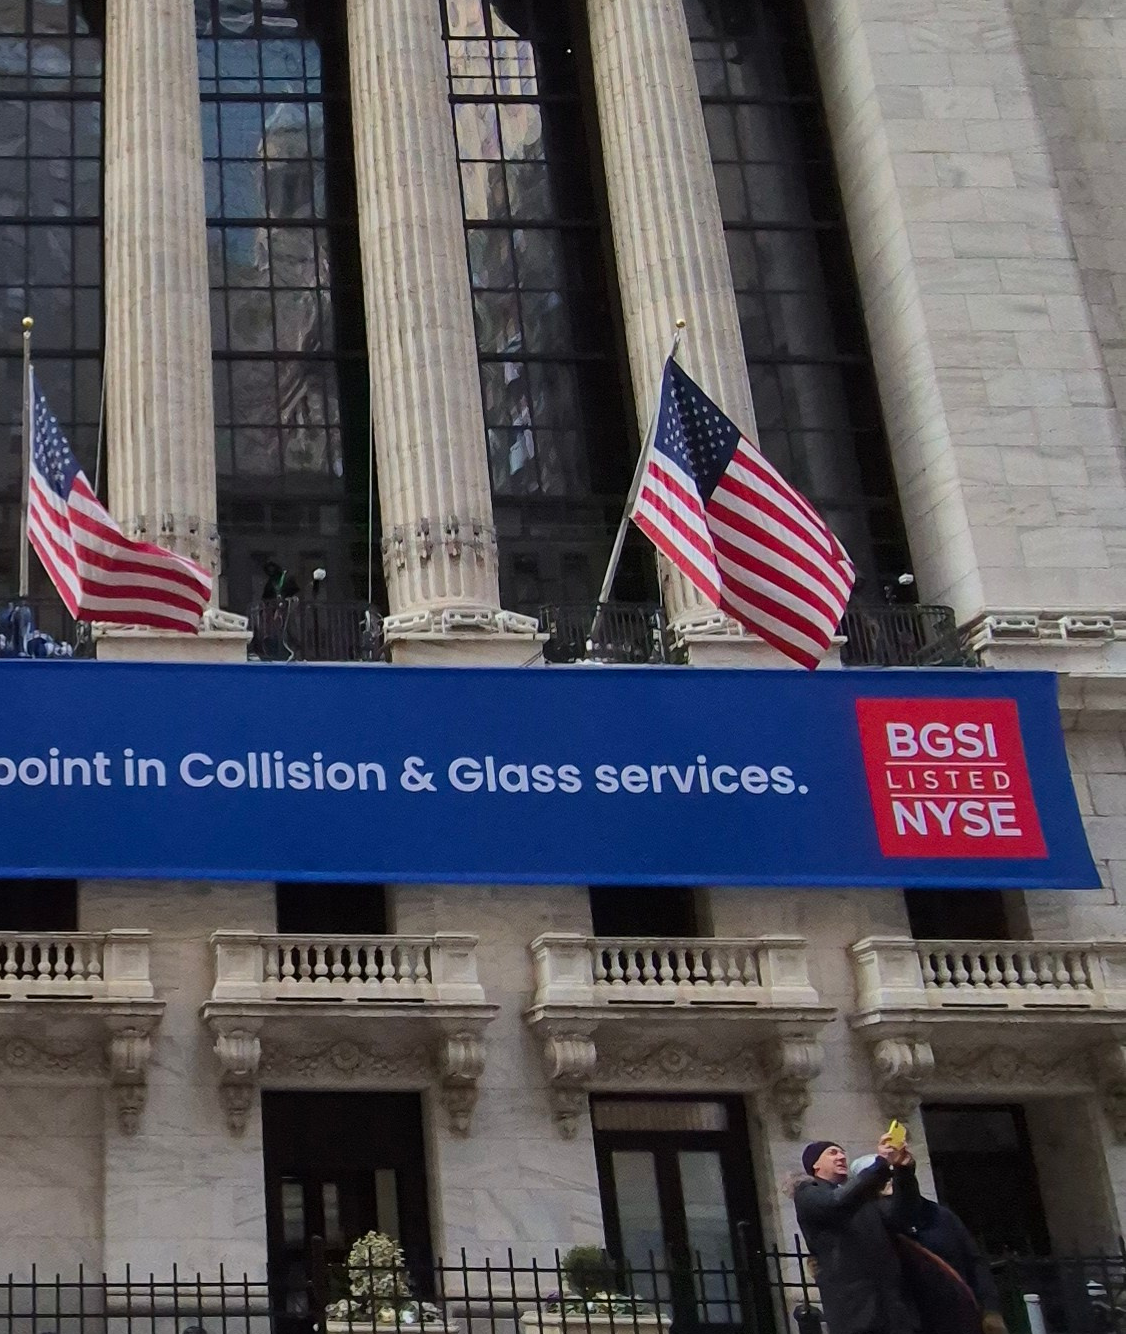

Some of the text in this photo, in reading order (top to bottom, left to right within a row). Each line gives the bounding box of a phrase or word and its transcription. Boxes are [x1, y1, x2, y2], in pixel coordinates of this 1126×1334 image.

[885, 721, 999, 760] BGSI
[123, 748, 166, 788] in
[179, 750, 387, 792] Collision
[399, 756, 438, 793] &
[448, 755, 583, 794] Glass
[595, 754, 809, 795] services.
[886, 770, 1011, 791] LISTED
[892, 800, 1023, 838] NYSE
